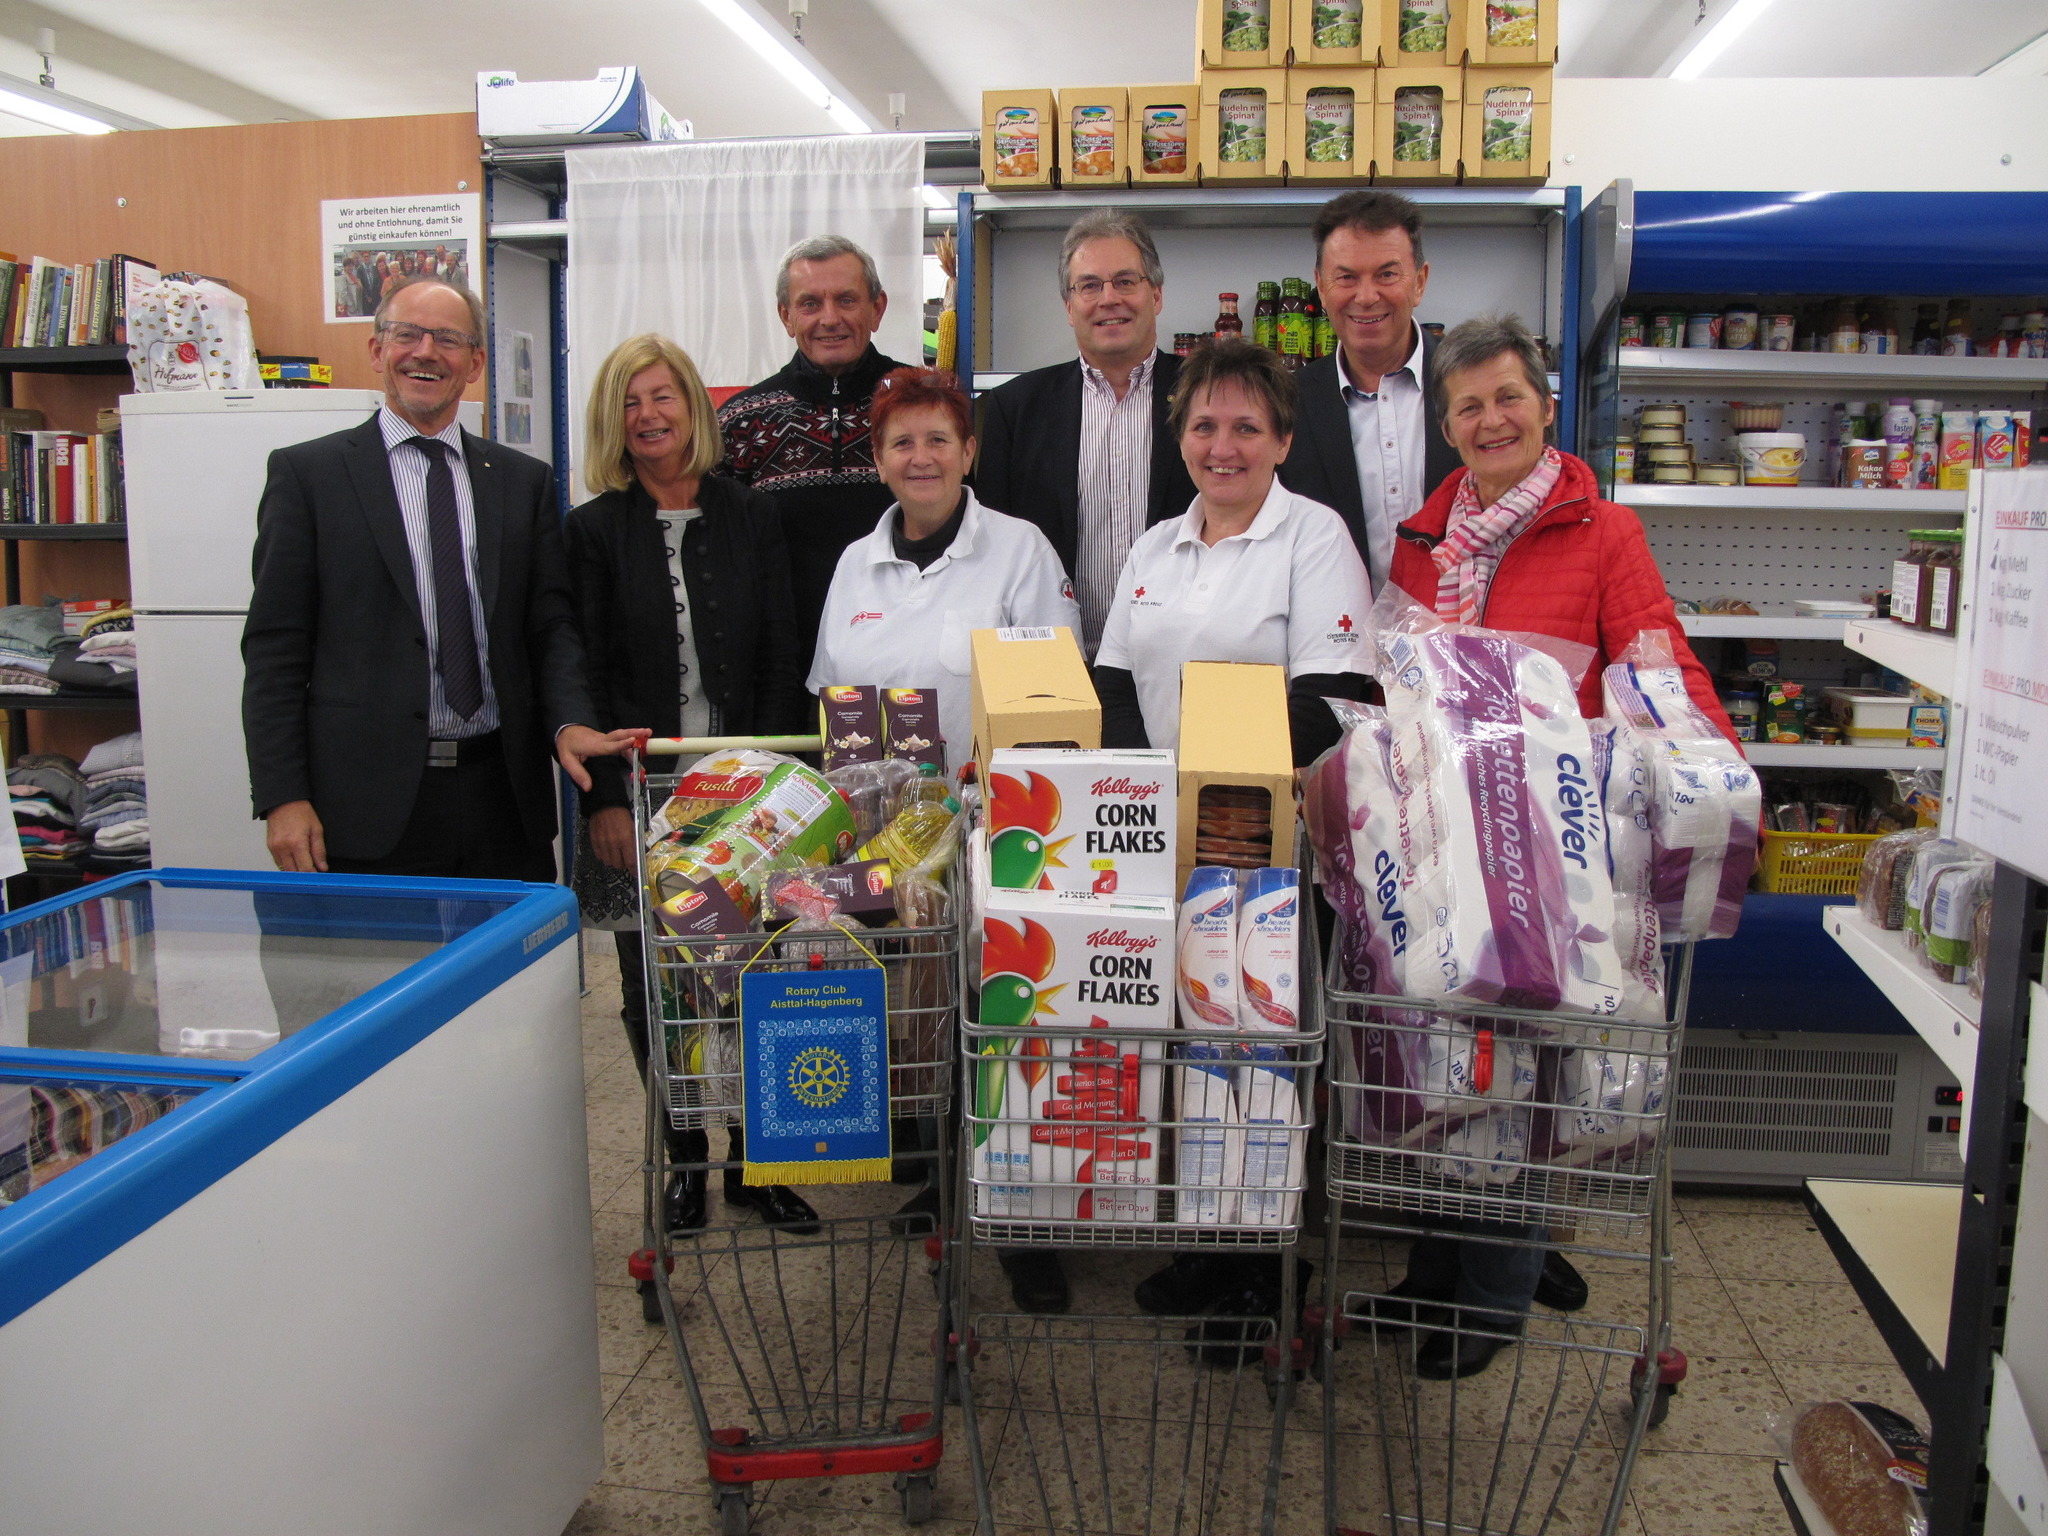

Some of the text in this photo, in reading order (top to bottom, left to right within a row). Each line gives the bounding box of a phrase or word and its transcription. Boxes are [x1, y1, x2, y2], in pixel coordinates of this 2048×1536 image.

[1253, 104, 1265, 112] mit
[1340, 103, 1352, 111] mit
[1427, 104, 1439, 112] mit
[1486, 100, 1517, 109] Nudeln
[1228, 111, 1256, 121] Spinat
[1315, 110, 1343, 119] Spinat
[1403, 111, 1431, 121] Spinat
[1496, 108, 1524, 117] Spinat
[340, 203, 461, 217] Wir arbeiten hier ehrenamtlich
[338, 215, 463, 229] und ohne Entlohnung, damit Sie
[348, 228, 452, 242] günstig einkaufen können!
[56, 438, 69, 466] Böll
[1996, 510, 2048, 527] EINKAUF PRO
[2016, 677, 2031, 696] PRO
[837, 693, 860, 701] Lipton
[695, 780, 738, 793] Fusilli
[1091, 777, 1161, 800] Kellogg's
[1095, 804, 1157, 827] CORN
[1426, 794, 1437, 839] weiches
[1086, 830, 1166, 854] FLAKES
[872, 873, 880, 893] Lipton
[679, 894, 705, 911] Lipton
[690, 911, 719, 929] Camomile
[1086, 928, 1159, 953] Kellogg's
[1089, 955, 1152, 980] CORN
[786, 985, 847, 997] Rotary Club
[1078, 981, 1160, 1006] FLAKES
[770, 997, 863, 1009] Aisttal-Hagenberg
[805, 1052, 832, 1062] ROTARY
[1451, 1060, 1464, 1075] 10
[1457, 1076, 1467, 1084] x
[798, 1084, 843, 1103] INTERNATIONAL
